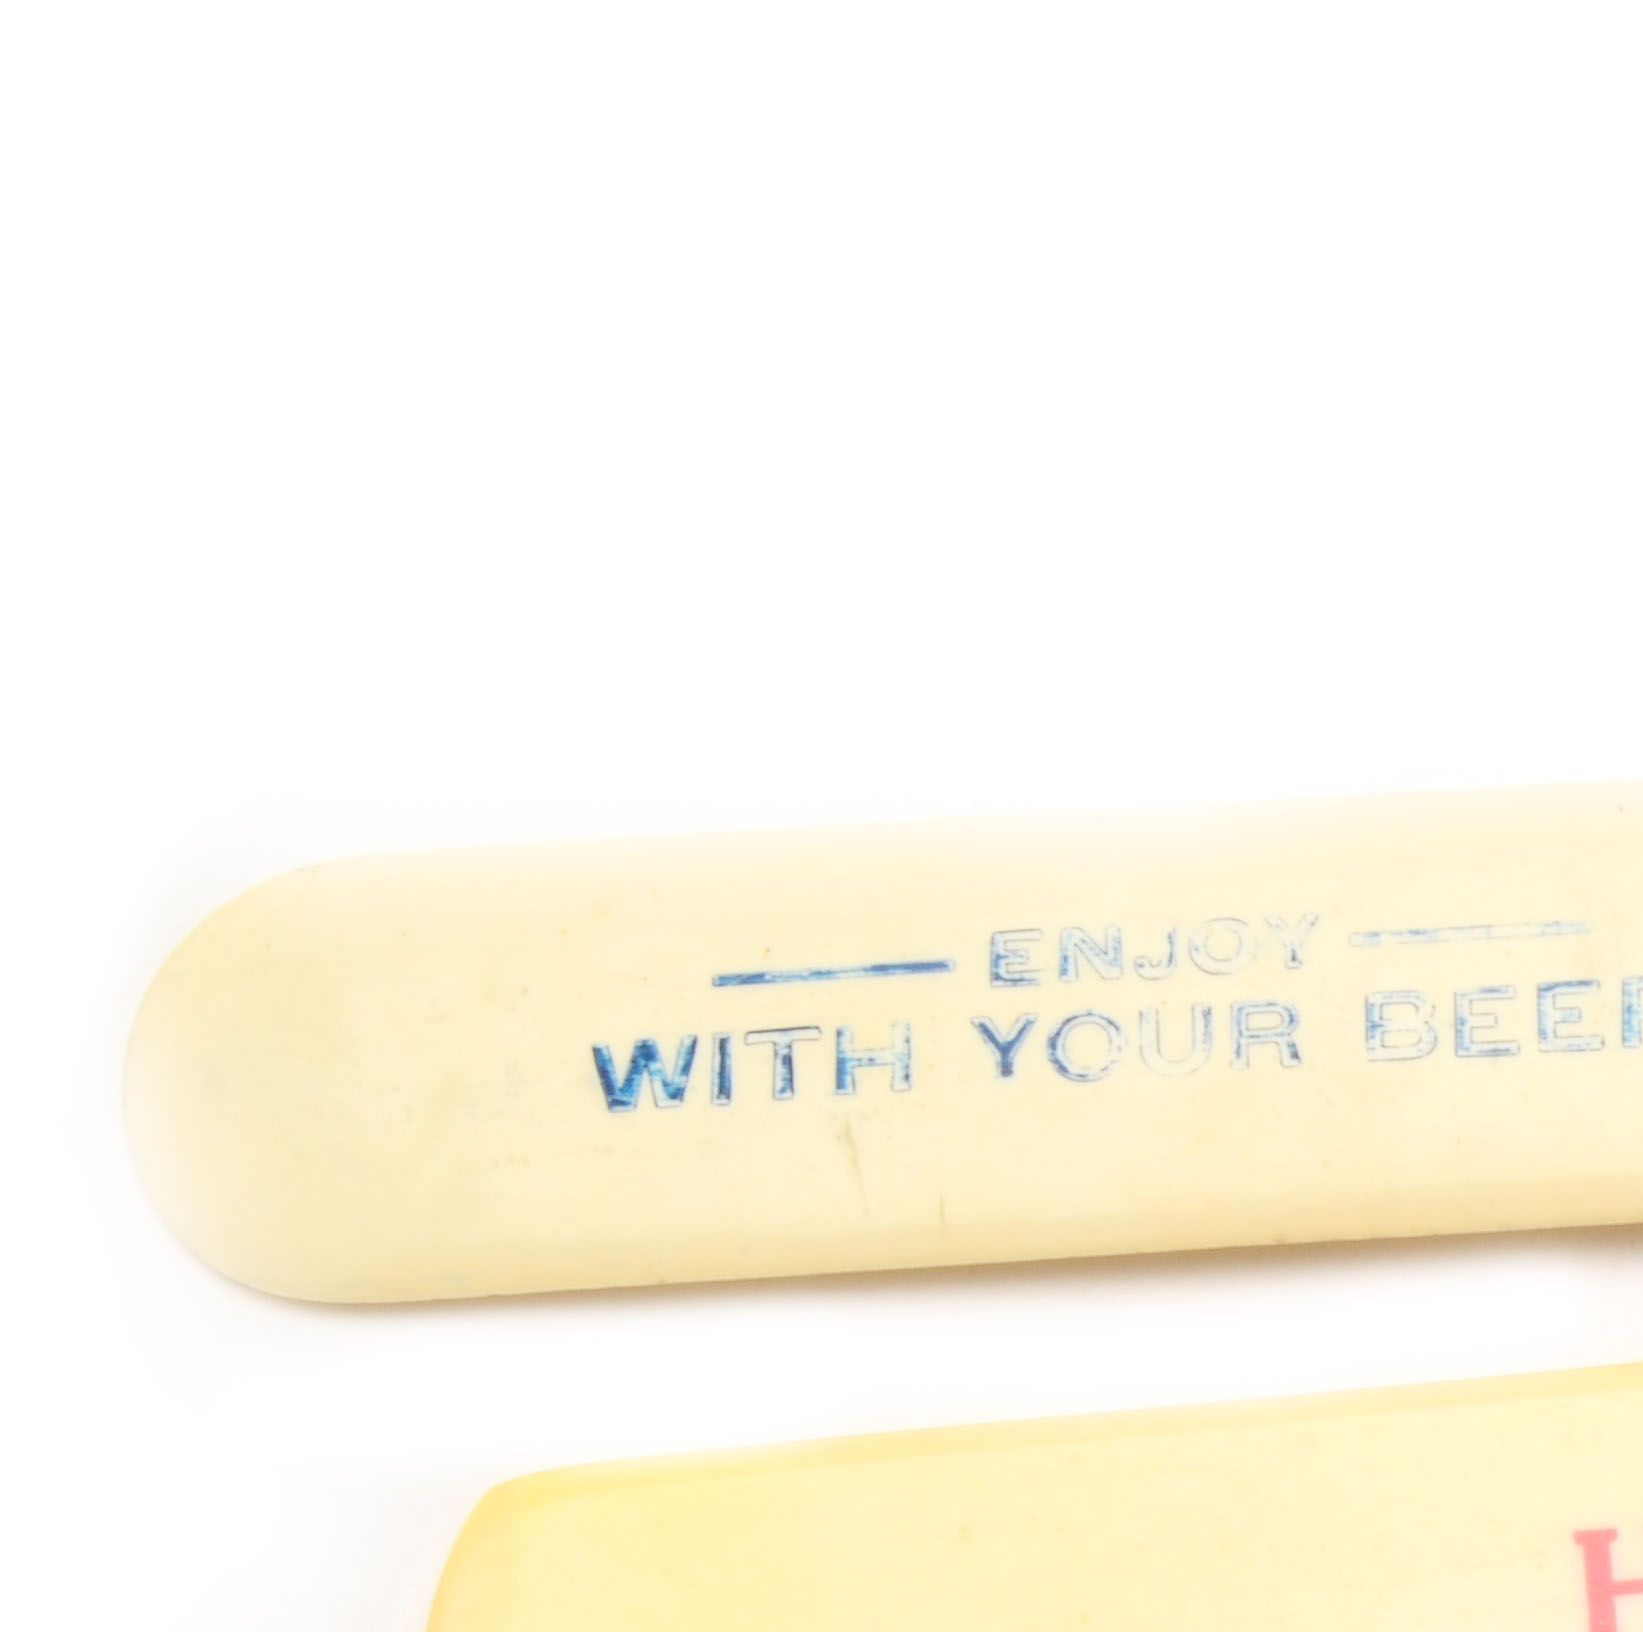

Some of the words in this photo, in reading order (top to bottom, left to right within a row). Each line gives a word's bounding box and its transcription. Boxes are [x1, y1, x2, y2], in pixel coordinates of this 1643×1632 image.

[988, 911, 1320, 990] ENJOY
[590, 1016, 914, 1114] WITH
[969, 998, 1302, 1083] YOUR
